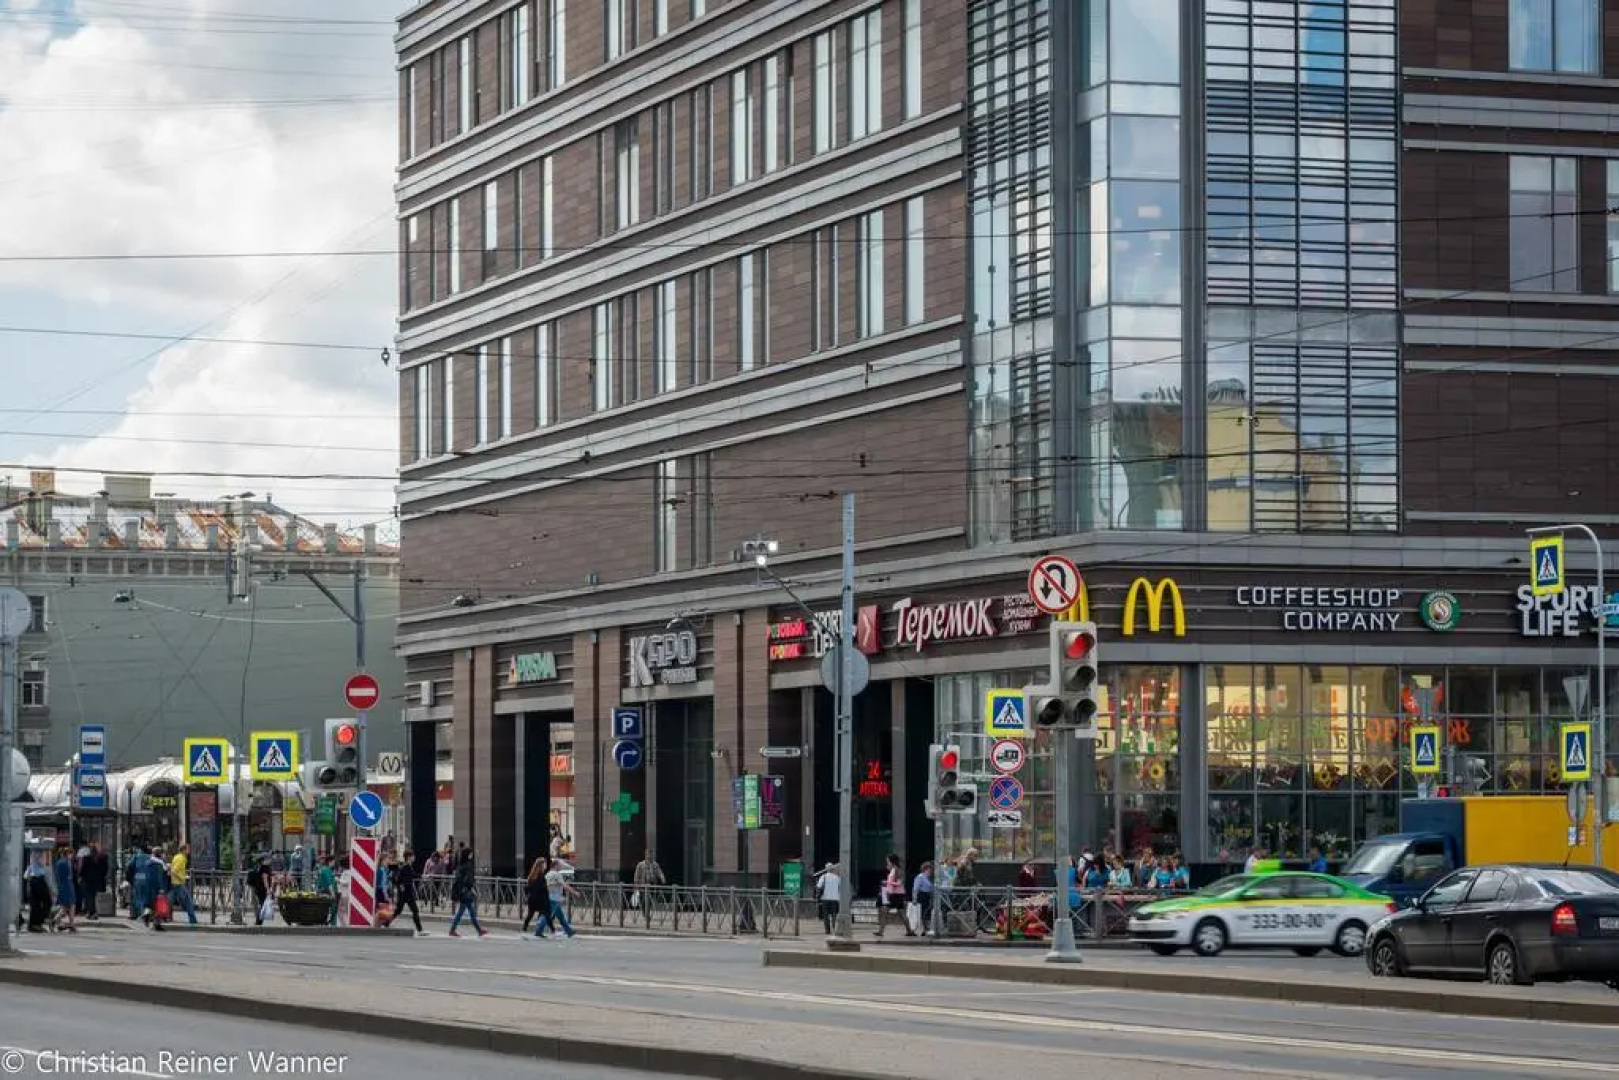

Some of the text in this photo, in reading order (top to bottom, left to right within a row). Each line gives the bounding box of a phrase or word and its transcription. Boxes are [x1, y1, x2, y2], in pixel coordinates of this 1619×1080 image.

[1237, 586, 1399, 607] COFFEESHOP
[1517, 585, 1603, 612] SPORT
[892, 597, 994, 652] Теремок
[1284, 611, 1400, 631] COMPANY
[1523, 609, 1580, 636] LIFE
[622, 718, 634, 733] P
[1252, 913, 1326, 929] 333-00-00
